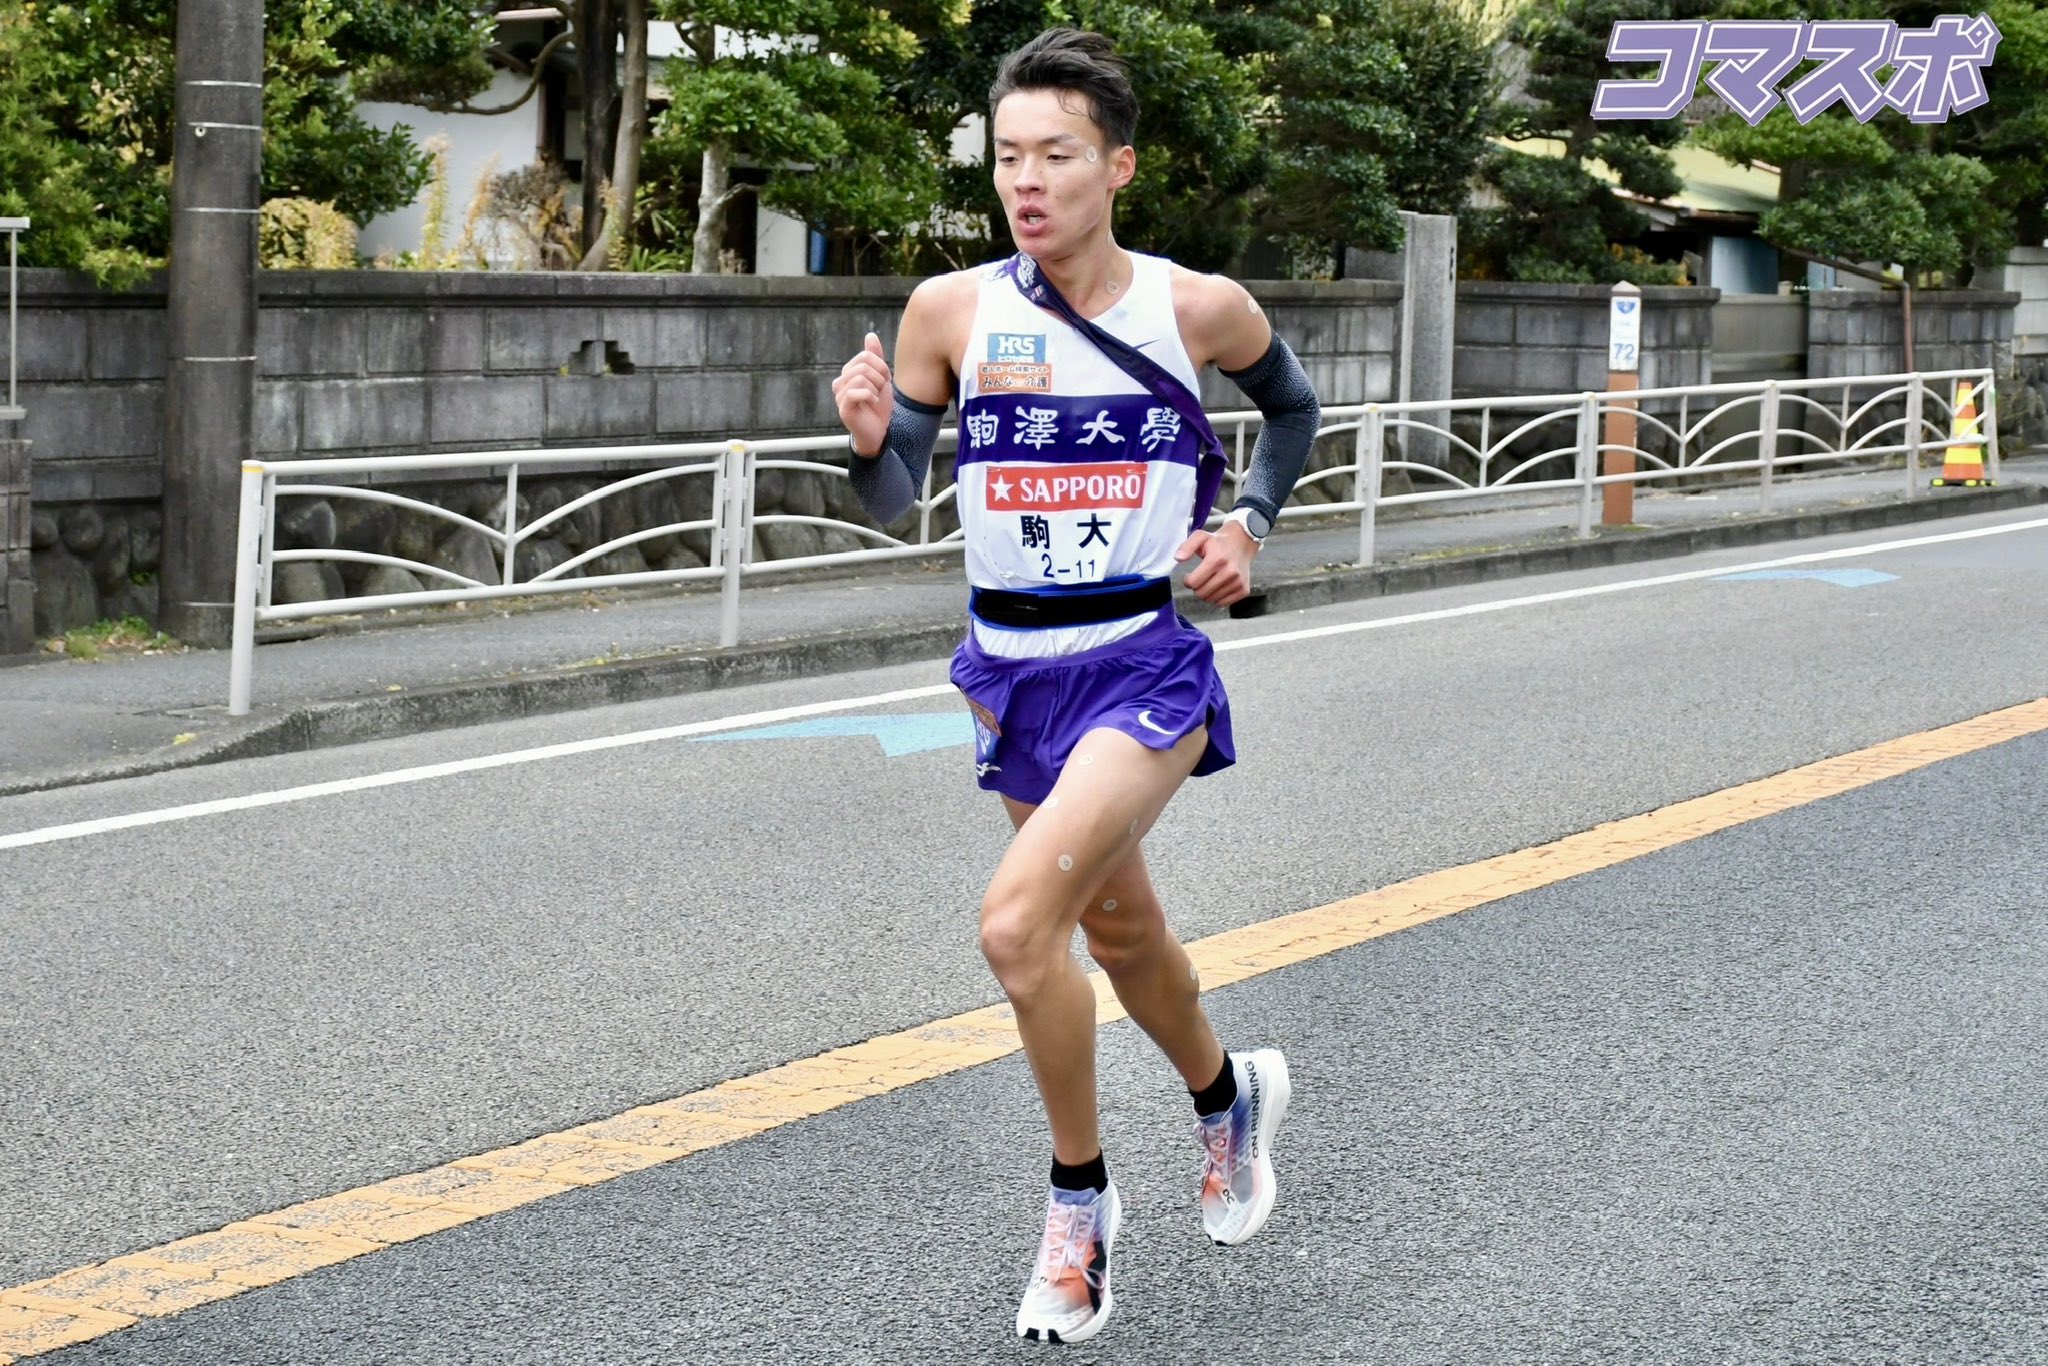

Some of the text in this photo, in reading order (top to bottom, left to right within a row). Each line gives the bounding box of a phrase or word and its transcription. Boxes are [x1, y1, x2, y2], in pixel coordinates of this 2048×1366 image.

[998, 336, 1035, 354] HRS
[1614, 343, 1635, 360] 72
[1020, 473, 1142, 504] SAPPORO
[1041, 553, 1096, 579] 2-11
[1244, 1060, 1260, 1158] ON RUNNING
